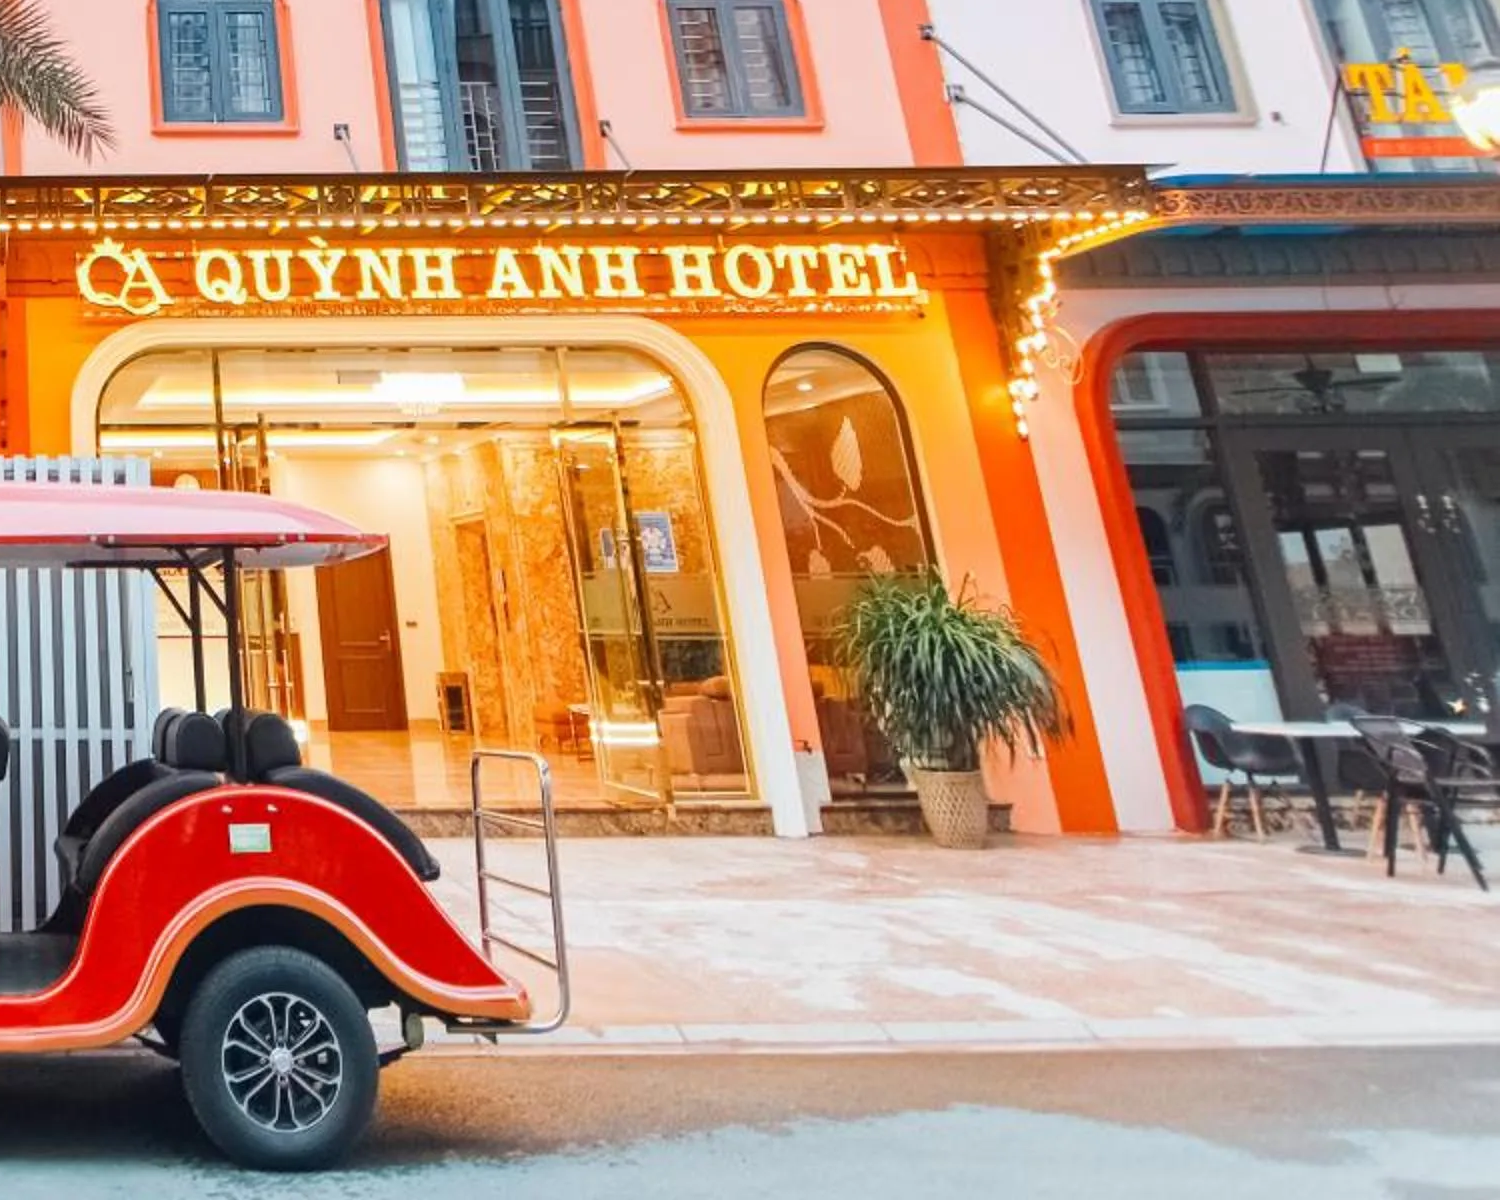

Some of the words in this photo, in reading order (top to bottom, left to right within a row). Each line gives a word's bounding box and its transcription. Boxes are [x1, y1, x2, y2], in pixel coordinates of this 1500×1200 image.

[194, 236, 462, 304] QUỲNH
[486, 244, 644, 299] ANH
[660, 243, 920, 299] HOTEL
